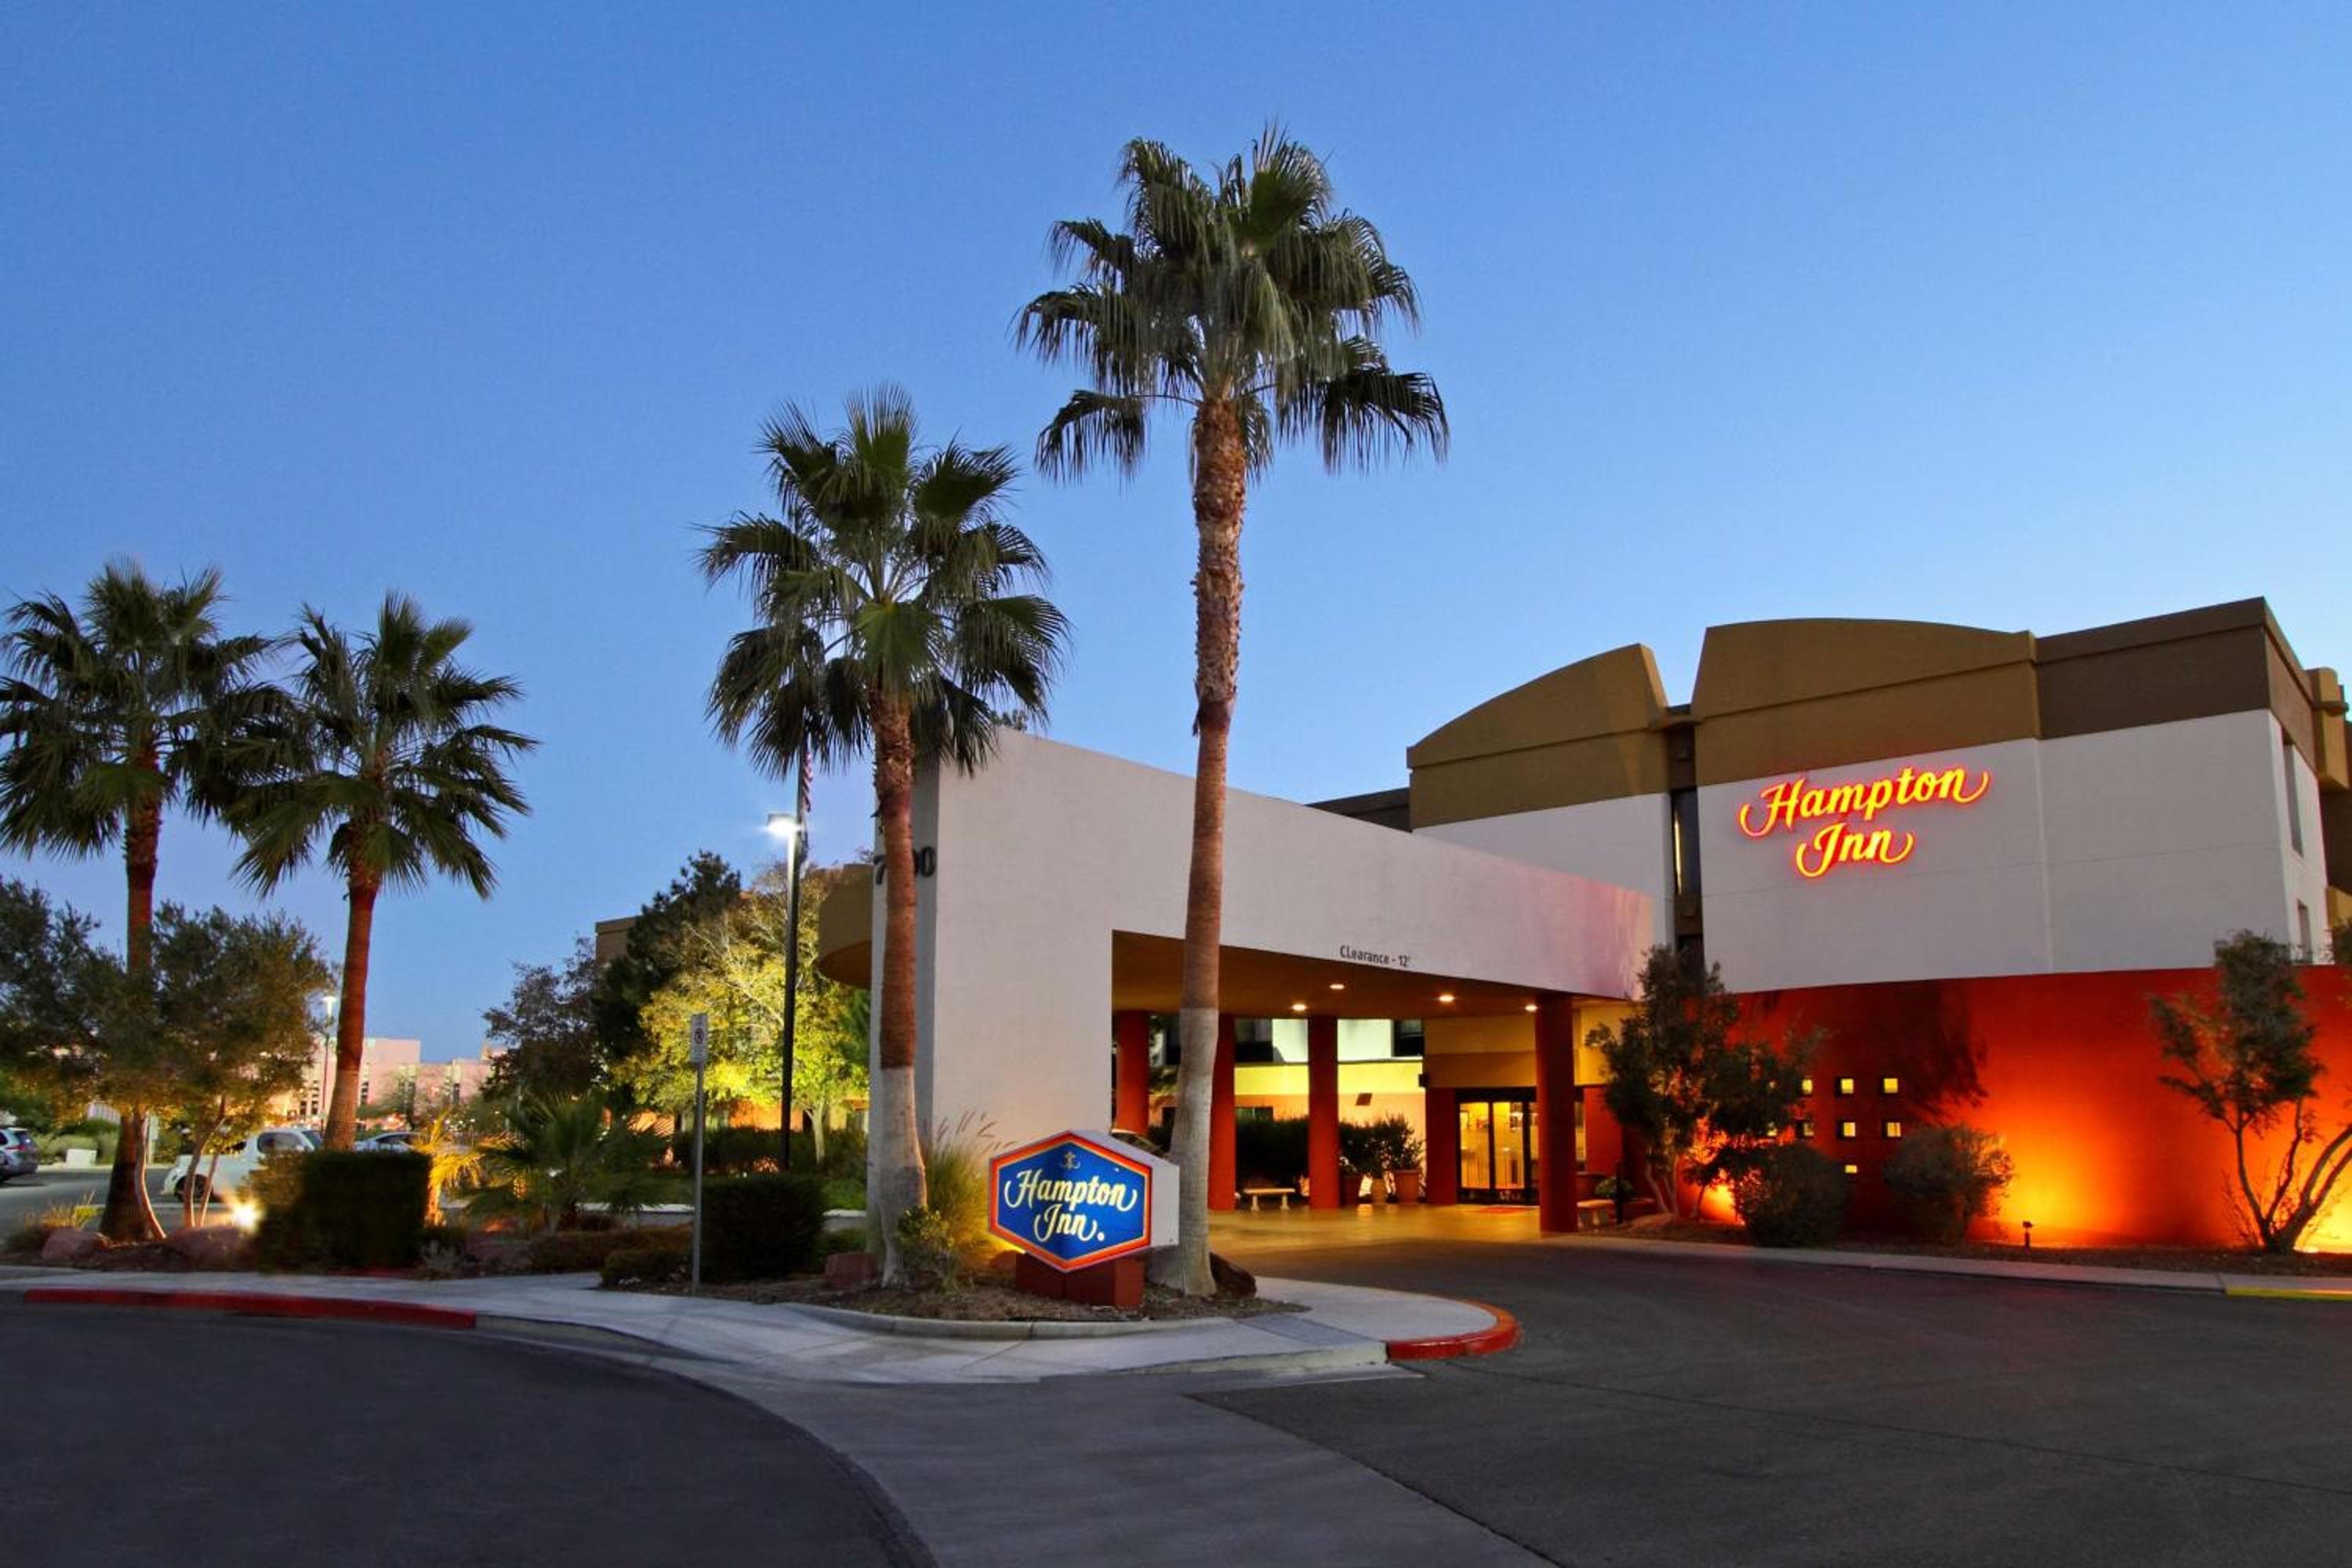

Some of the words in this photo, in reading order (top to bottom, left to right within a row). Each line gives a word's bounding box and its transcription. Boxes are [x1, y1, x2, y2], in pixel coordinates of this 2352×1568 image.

[1738, 765, 1990, 837] Hampton
[1795, 822, 1914, 878] Inn
[1340, 945, 1389, 964] Clearance
[1004, 1168, 1138, 1211] Hampton
